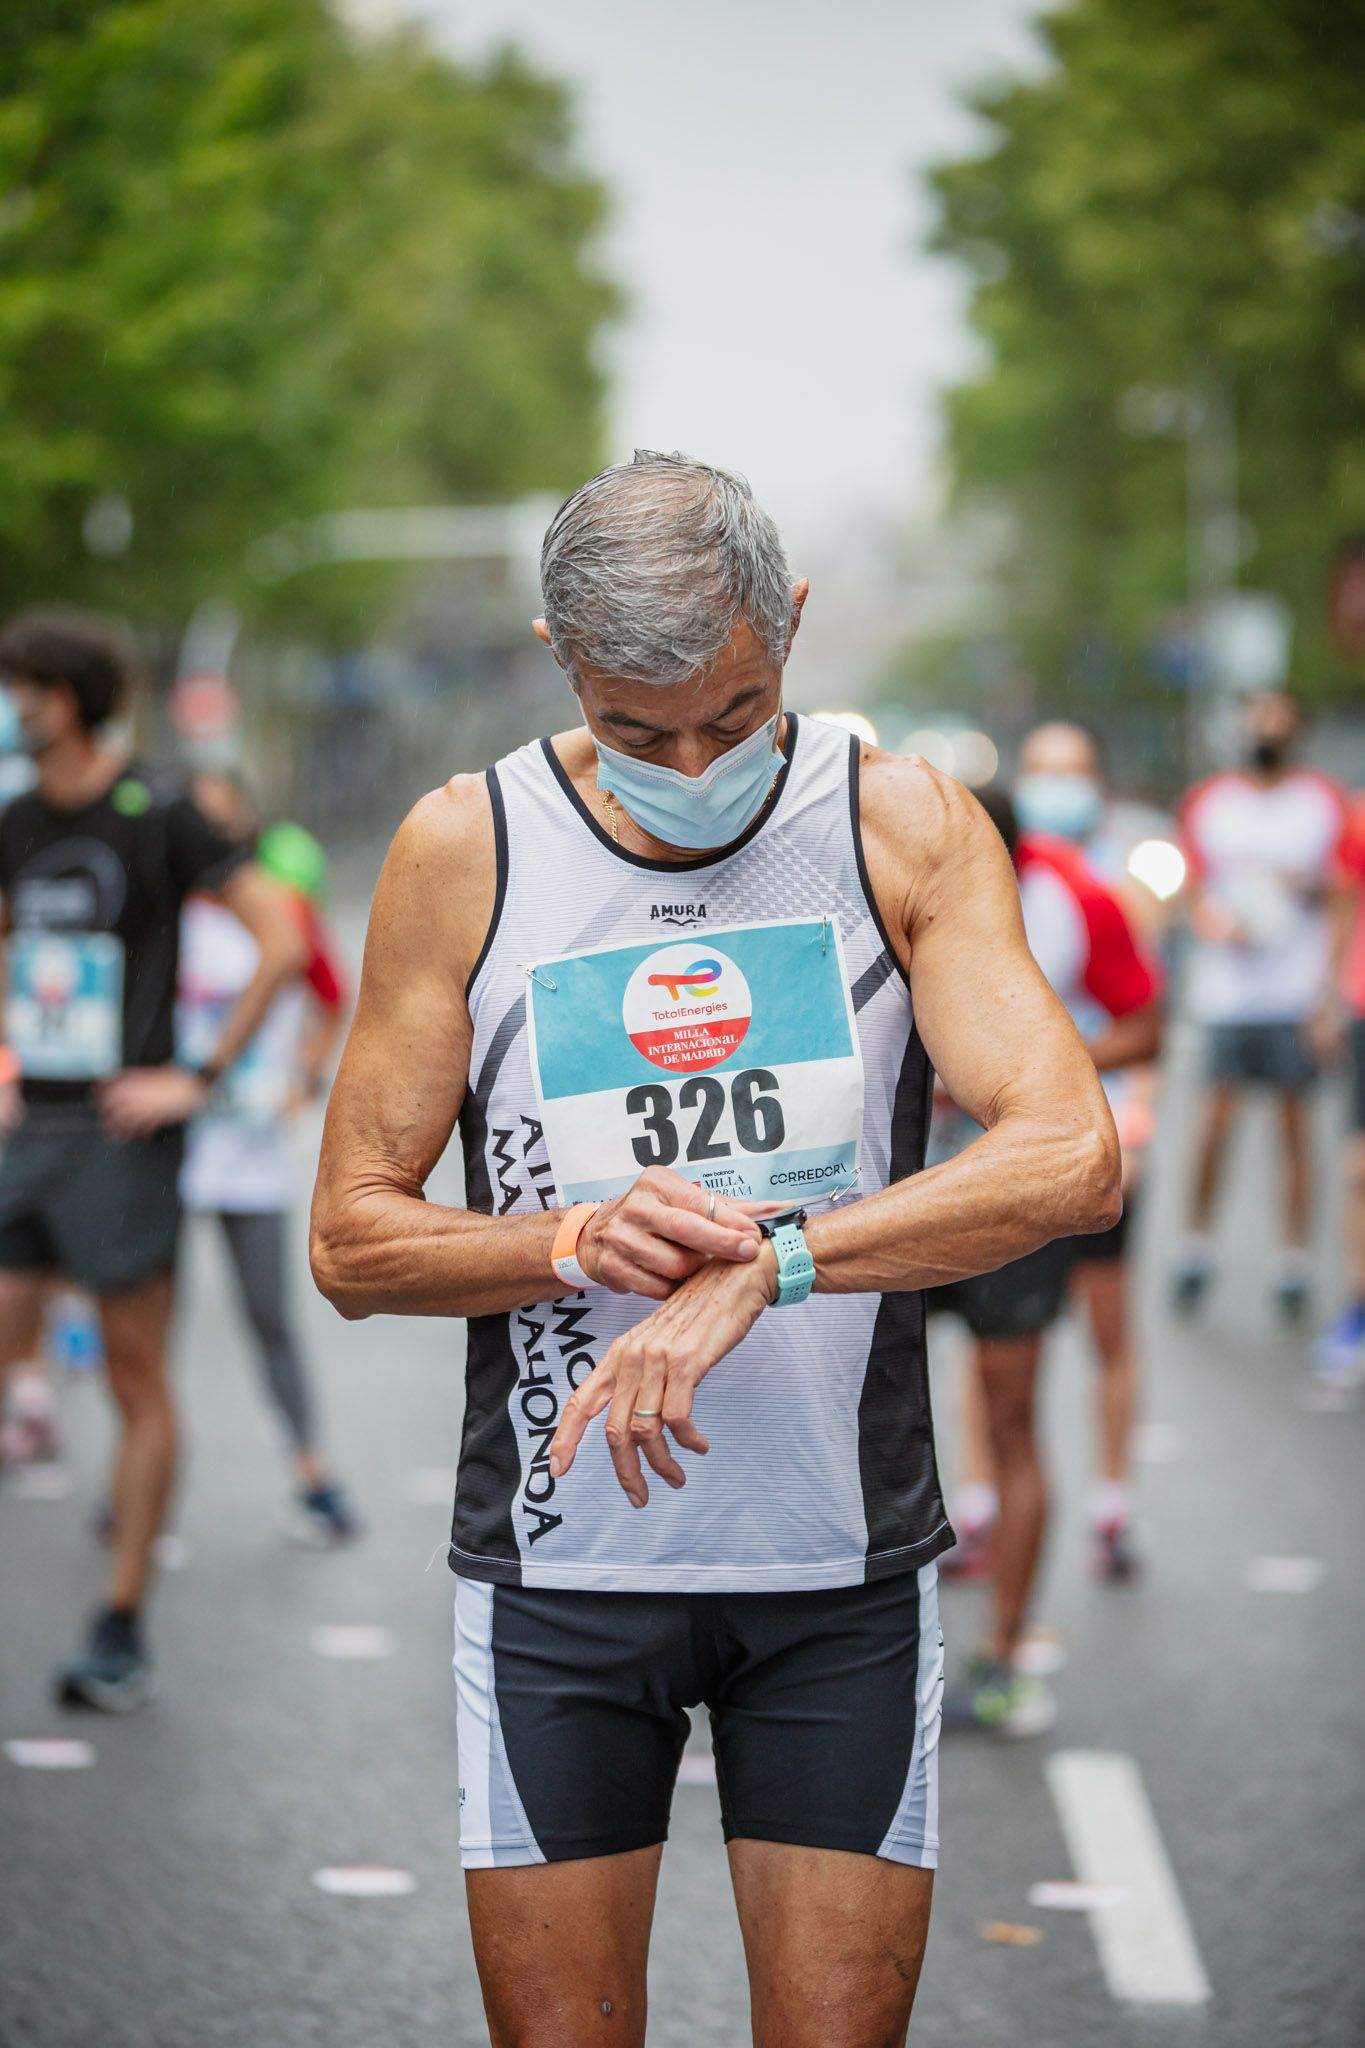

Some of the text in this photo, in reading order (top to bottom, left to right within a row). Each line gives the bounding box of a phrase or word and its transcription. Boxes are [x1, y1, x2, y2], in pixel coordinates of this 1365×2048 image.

[650, 904, 707, 920] AMURA
[652, 1002, 728, 1021] TotalEnergies
[674, 1027, 710, 1041] MILLA
[663, 1048, 726, 1065] DE MADRID
[626, 1068, 785, 1168] 326
[704, 1174, 745, 1189] MILLA
[492, 1128, 563, 1547] MAAHONDA
